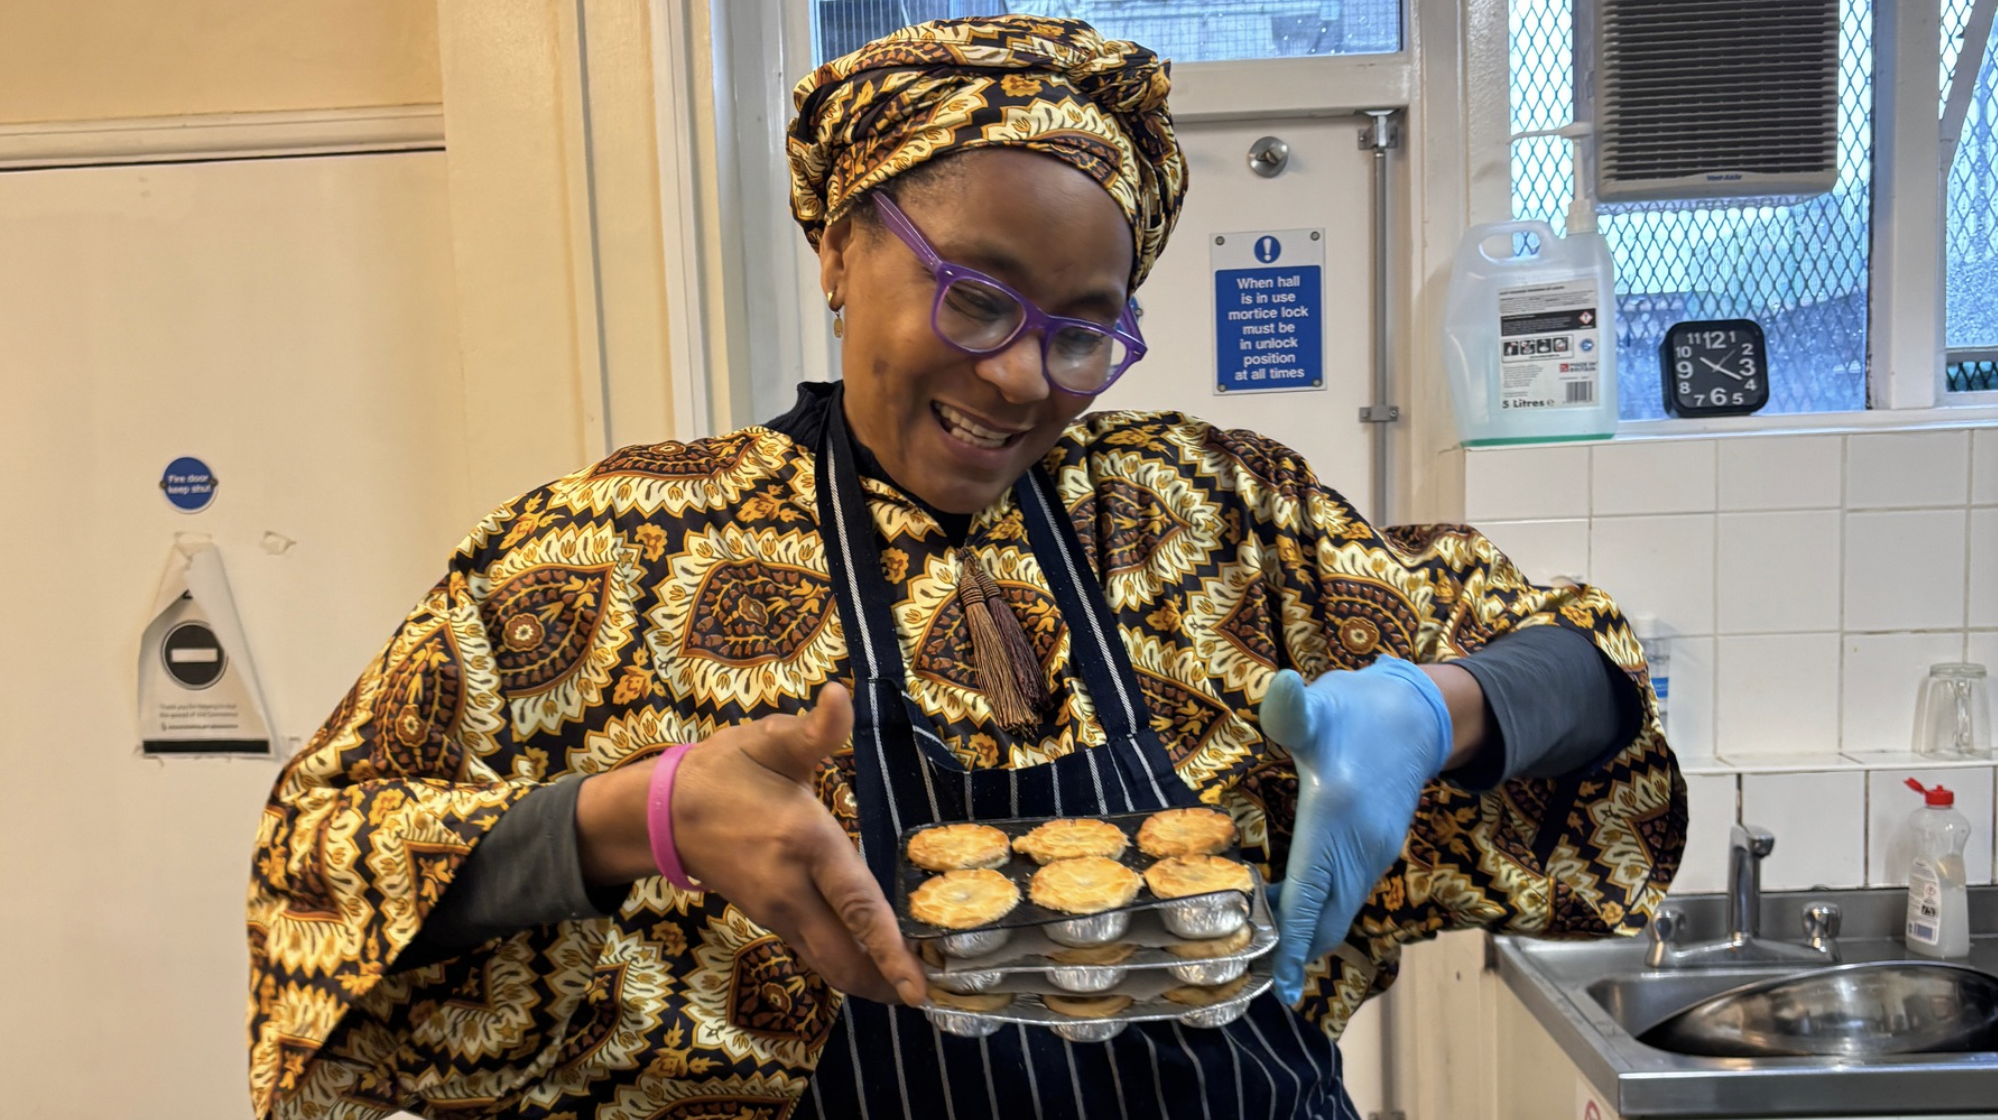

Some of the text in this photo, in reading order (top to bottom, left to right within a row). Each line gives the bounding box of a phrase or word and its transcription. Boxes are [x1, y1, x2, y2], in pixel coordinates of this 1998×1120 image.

[1236, 276, 1300, 289] When hall
[1241, 293, 1296, 304] is in use
[1228, 306, 1309, 320] mortice lock
[1243, 323, 1295, 334] must be
[1687, 332, 1701, 344] 11
[1703, 331, 1726, 349] 12
[1729, 331, 1736, 343] 1
[1240, 337, 1298, 350] in unlock
[1741, 343, 1754, 355] 2
[1676, 346, 1692, 358] 10
[1243, 353, 1296, 367] position
[1676, 361, 1694, 379] 9
[1739, 358, 1756, 376] 3
[1235, 368, 1305, 380] at all times
[1679, 382, 1691, 394] 8
[1744, 379, 1757, 391] 4
[1693, 394, 1705, 406] 7
[1710, 388, 1727, 406] 6
[1732, 393, 1744, 404] 5
[1513, 399, 1545, 408] Litres
[186, 474, 208, 483] door
